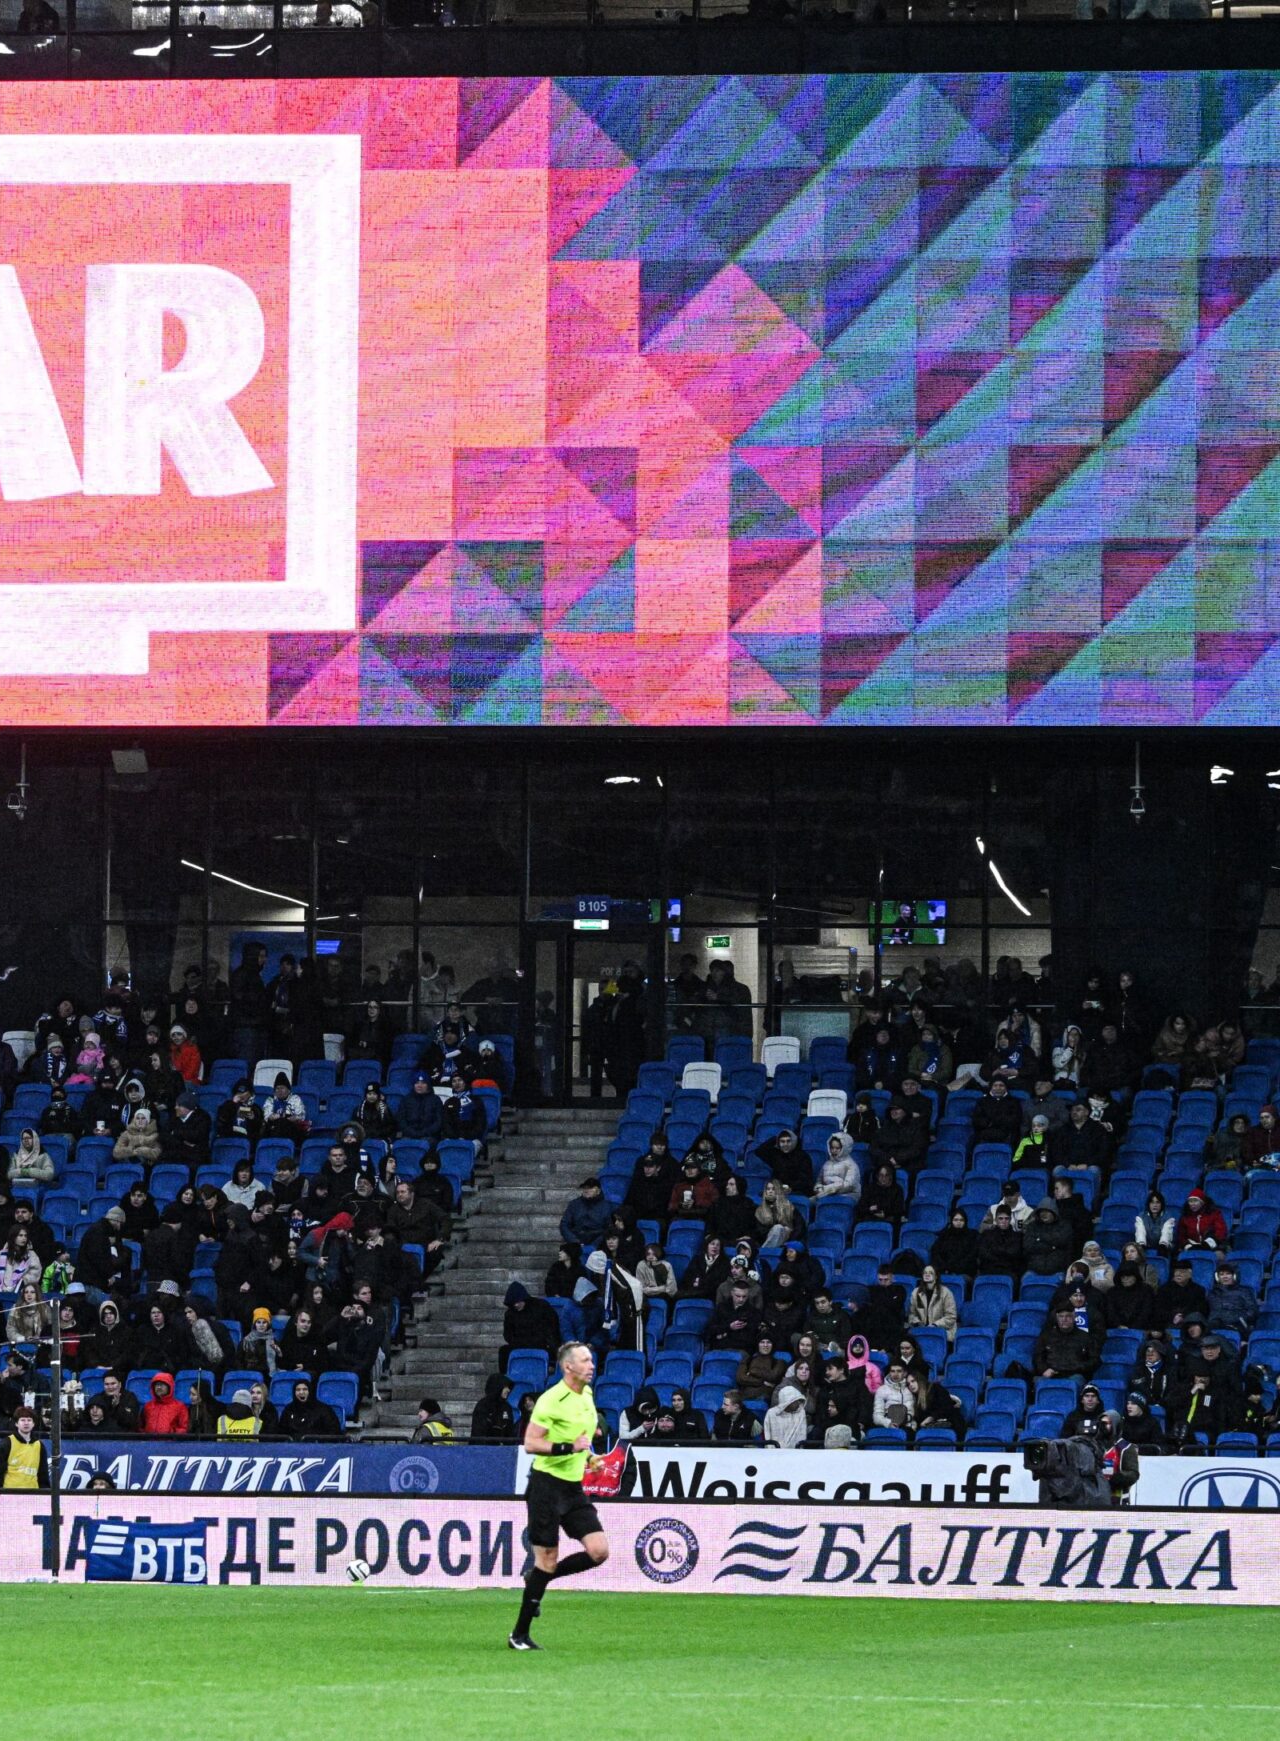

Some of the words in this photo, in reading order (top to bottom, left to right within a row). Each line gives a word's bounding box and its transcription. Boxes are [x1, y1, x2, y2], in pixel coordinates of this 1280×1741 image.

[588, 901, 607, 912] 105
[132, 1537, 207, 1582] ВТБ
[802, 1522, 1238, 1591] БАЛТИКА
